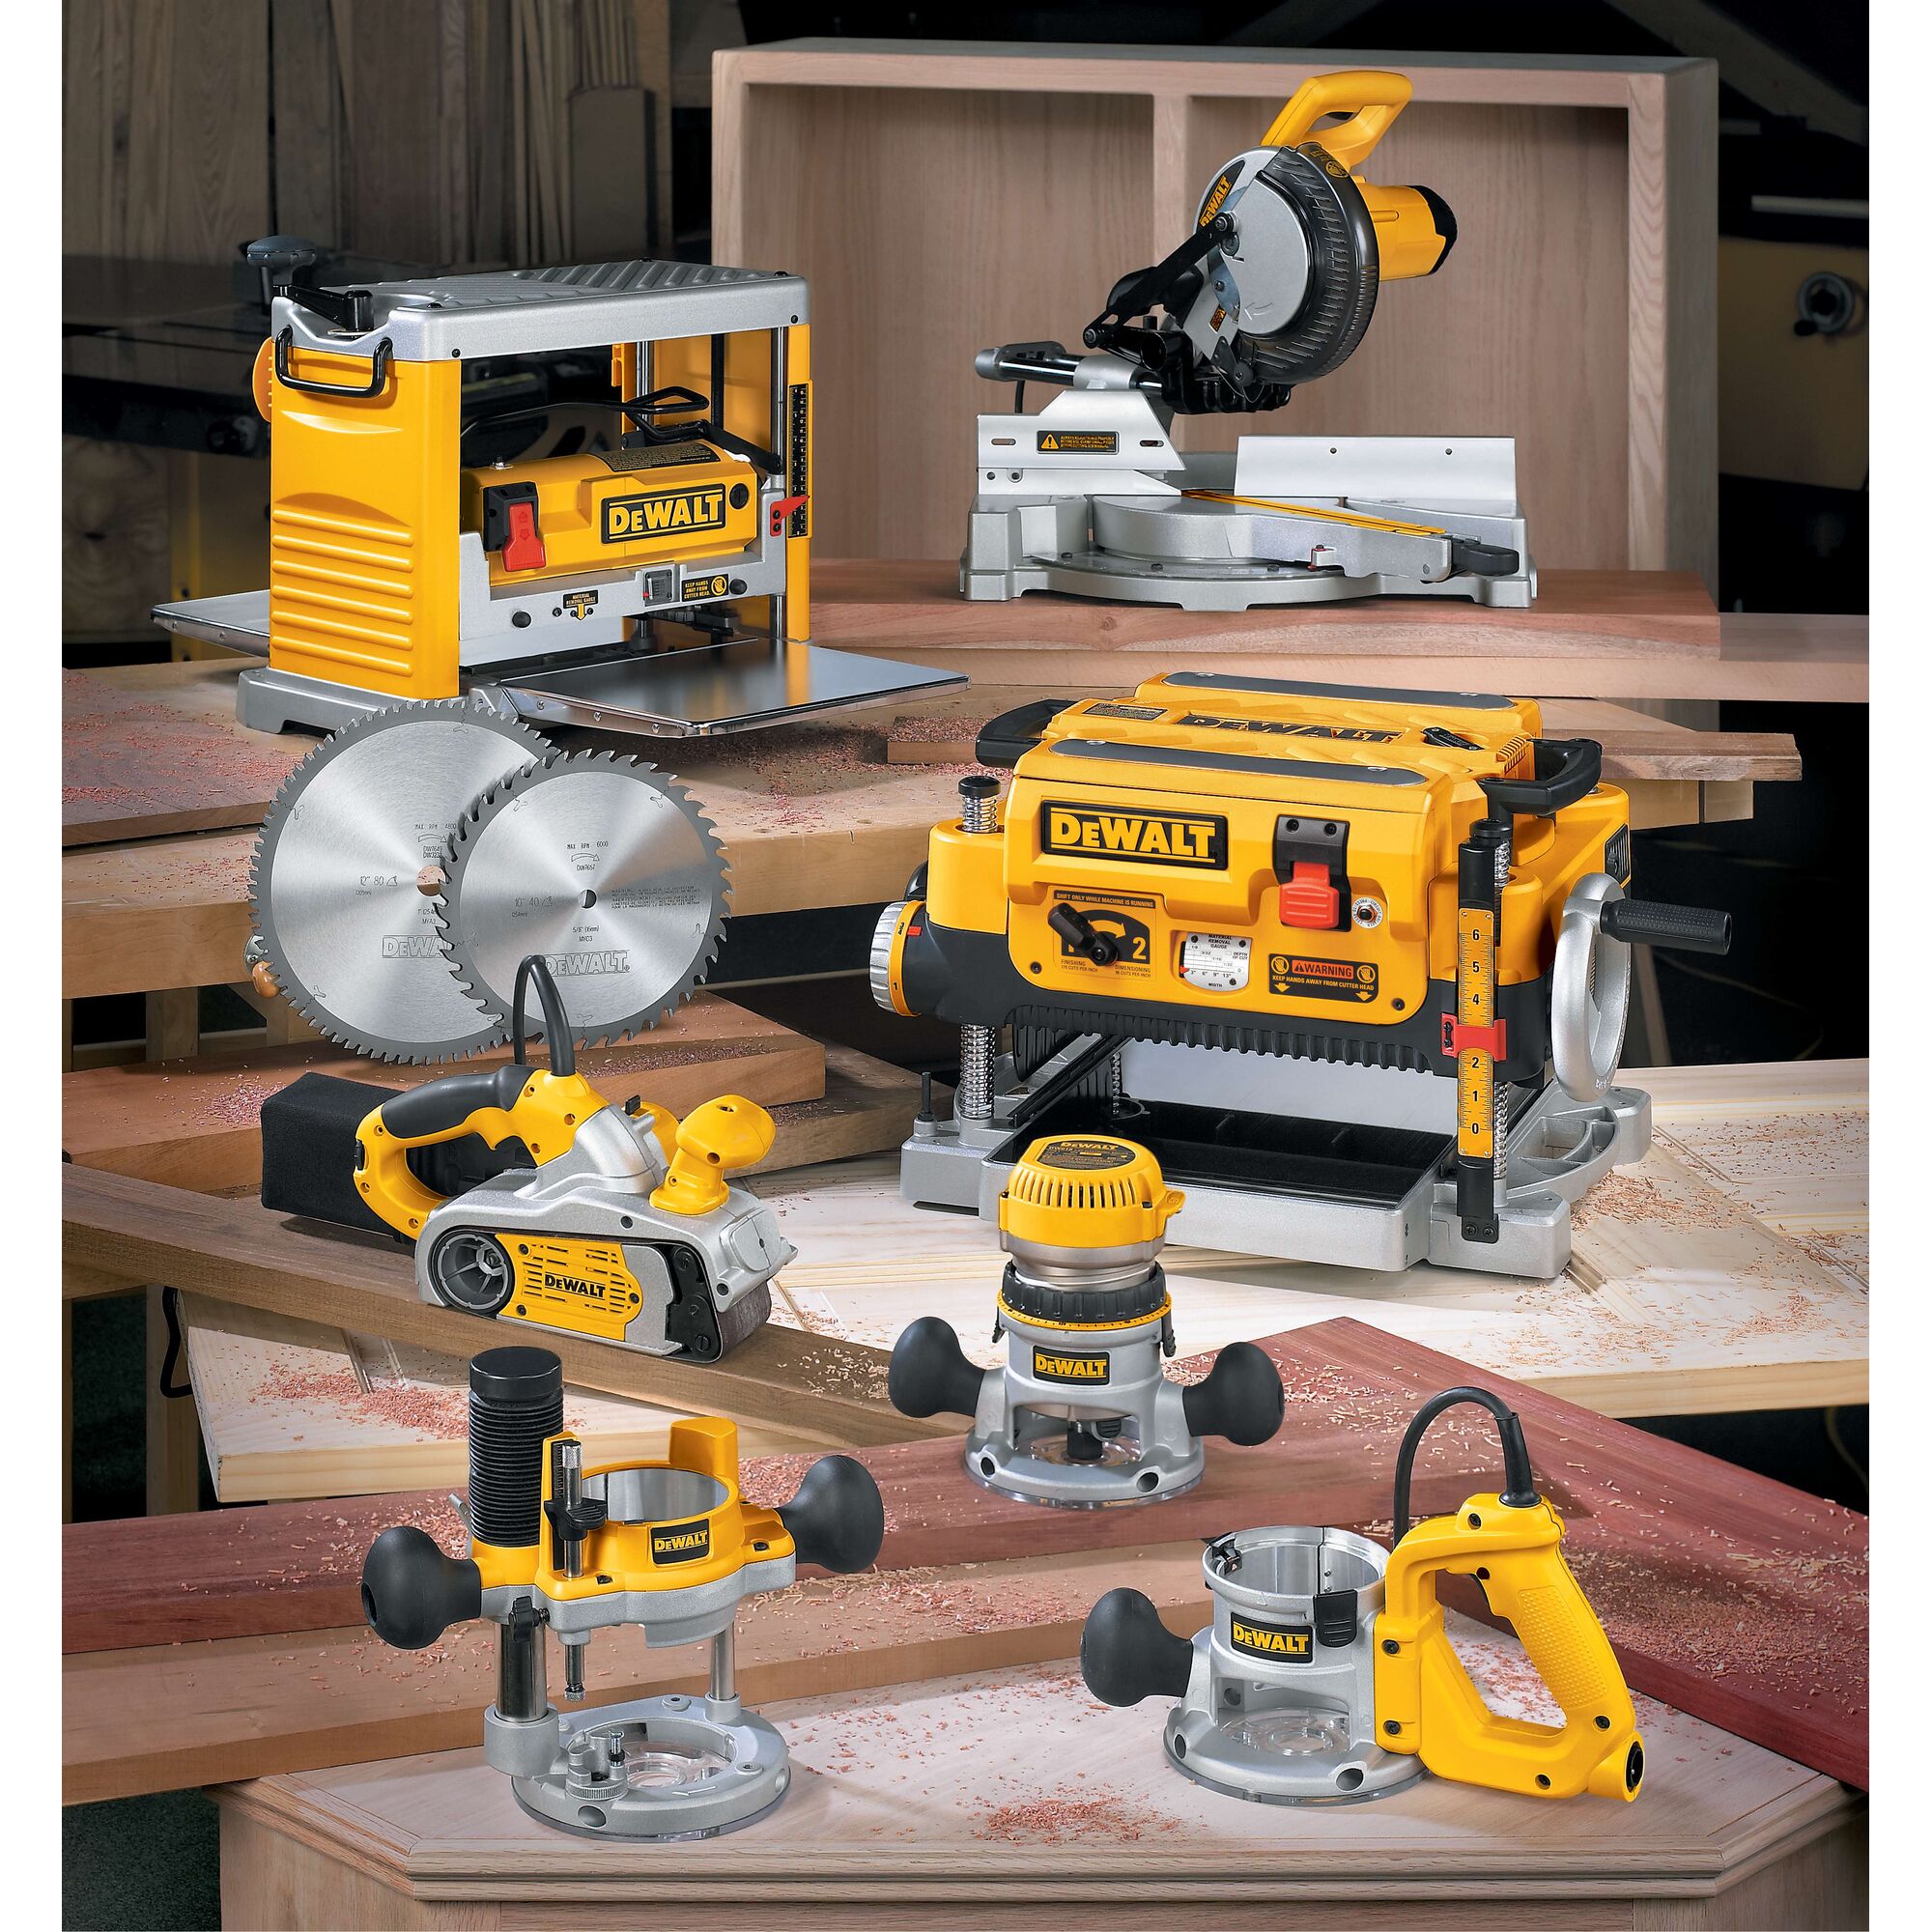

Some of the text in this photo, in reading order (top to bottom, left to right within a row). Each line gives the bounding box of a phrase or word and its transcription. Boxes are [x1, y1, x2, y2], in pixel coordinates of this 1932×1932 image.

[609, 494, 724, 535] DEWALT
[1178, 715, 1402, 744] DEWALT
[1051, 812, 1215, 858] DEWALT
[373, 875, 384, 886] 80
[1130, 899, 1154, 908] RUNNING
[1472, 929, 1480, 941] 6
[382, 936, 452, 957] DEWA
[1132, 936, 1147, 960] 2
[1304, 963, 1352, 978] WARNING
[1472, 961, 1480, 973] 5
[1472, 993, 1480, 1006] 4
[1471, 1057, 1480, 1068] 2
[1472, 1090, 1478, 1102] 1
[1471, 1122, 1479, 1135] 0
[1061, 1142, 1119, 1151] DEWALT
[545, 1274, 606, 1298] DEWALT
[1036, 1356, 1107, 1376] DEWALT
[654, 1532, 708, 1550] DEWALT
[1233, 1624, 1309, 1652] DEWALT
